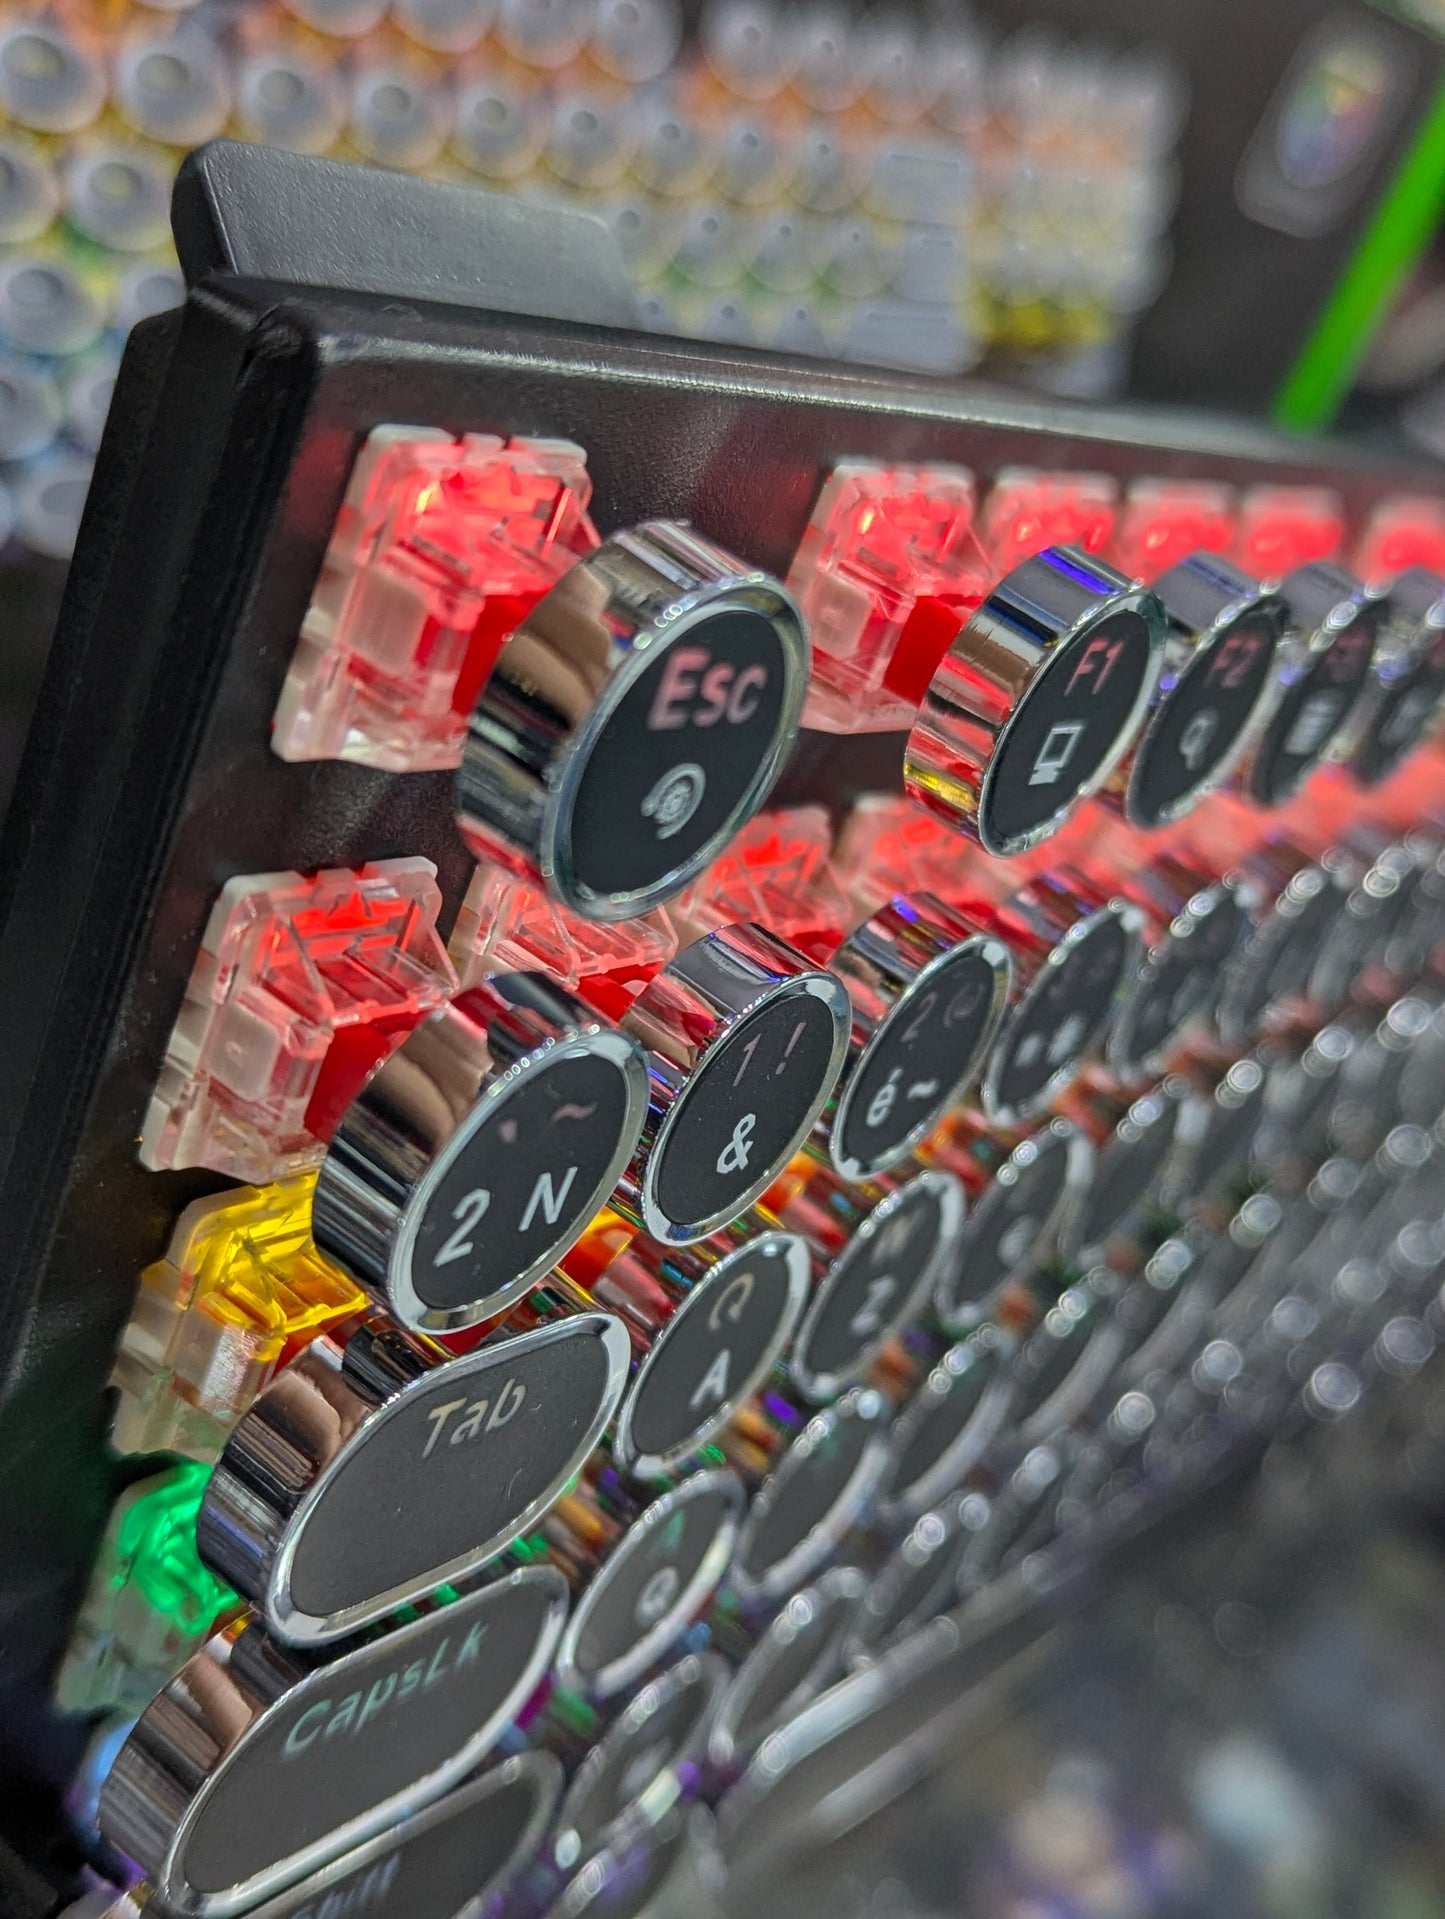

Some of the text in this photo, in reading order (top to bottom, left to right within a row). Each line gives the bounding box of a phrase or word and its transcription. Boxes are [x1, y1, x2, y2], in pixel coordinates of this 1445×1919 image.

[646, 647, 767, 732] Esc
[1064, 635, 1127, 697] F1
[732, 1020, 807, 1088] 1 !
[715, 1112, 757, 1175] &
[517, 1165, 579, 1232] N
[689, 1348, 732, 1408] A
[422, 1376, 527, 1459] Tab
